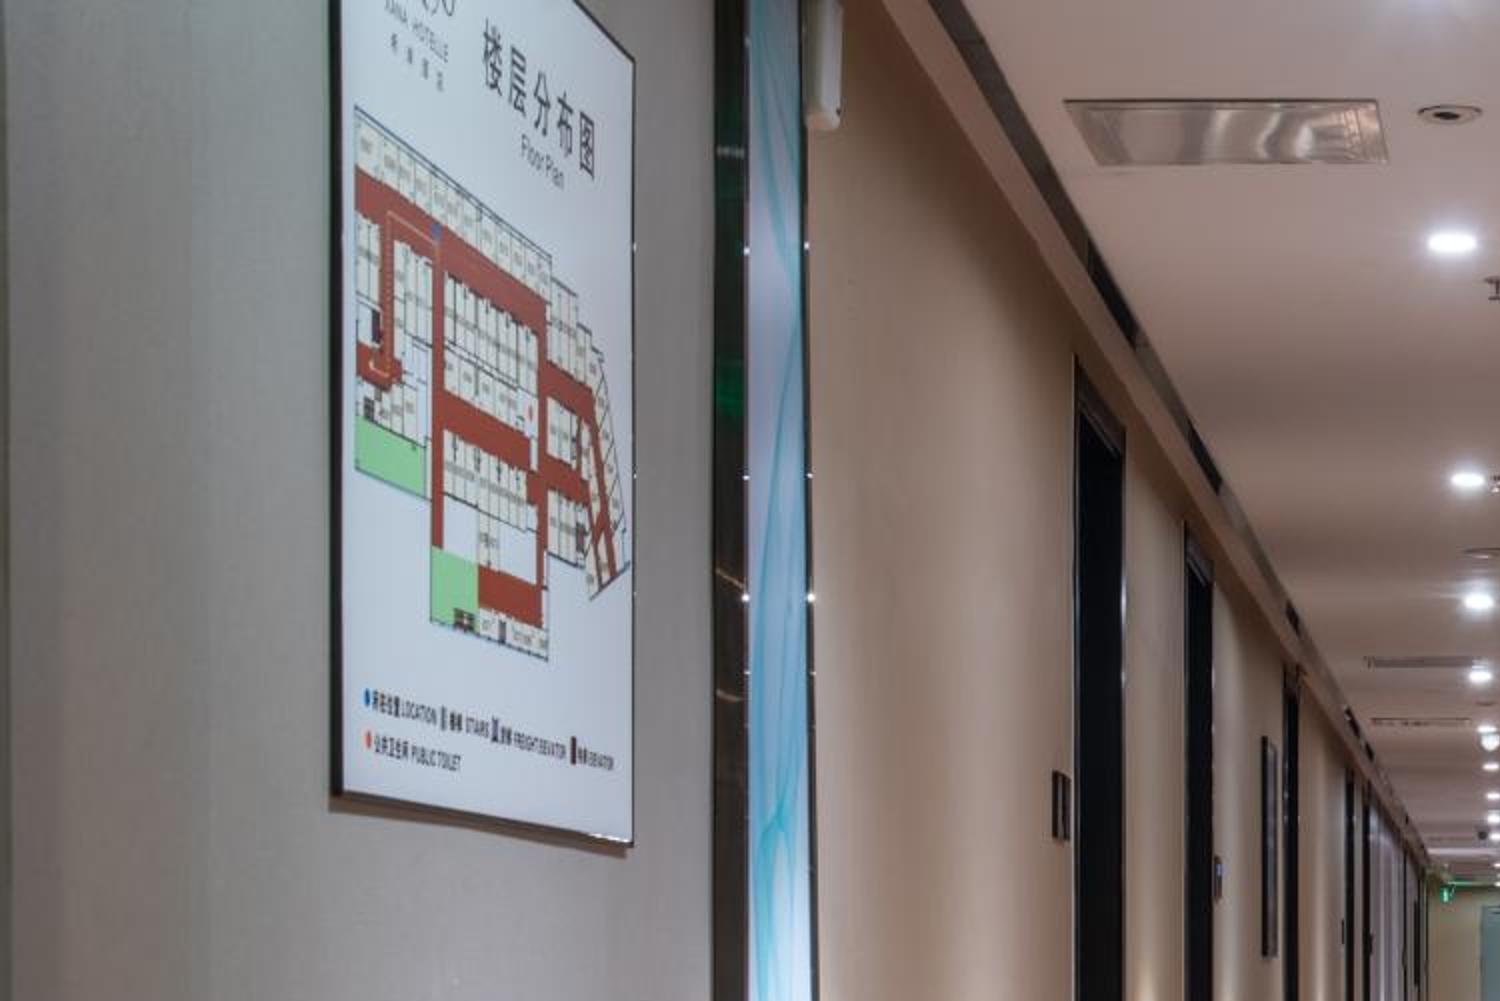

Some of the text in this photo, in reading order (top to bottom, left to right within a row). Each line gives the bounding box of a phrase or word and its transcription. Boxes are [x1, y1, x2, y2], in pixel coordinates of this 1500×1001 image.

[484, 17, 595, 180] 楼层分布图
